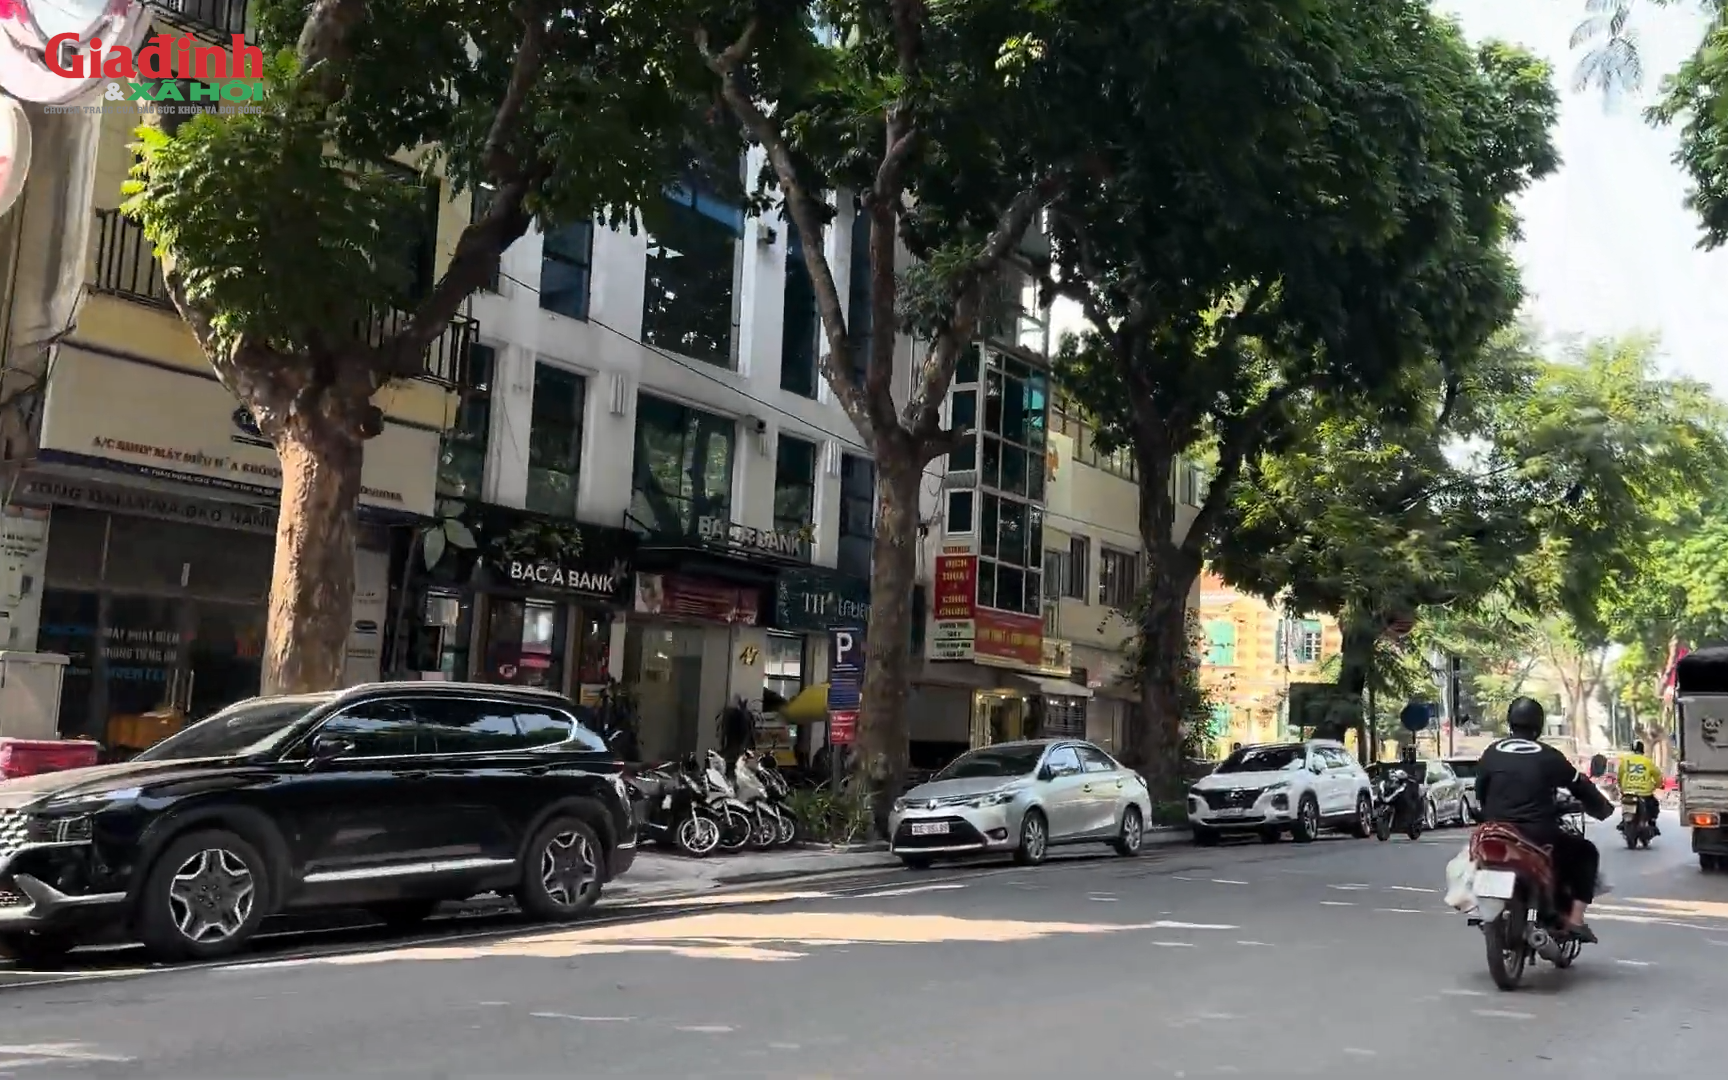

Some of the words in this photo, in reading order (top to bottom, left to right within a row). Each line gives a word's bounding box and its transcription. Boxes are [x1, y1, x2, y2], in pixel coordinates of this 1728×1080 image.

[511, 561, 548, 582] BAC
[551, 568, 564, 585] A
[568, 569, 613, 592] BANK
[836, 632, 853, 664] P
